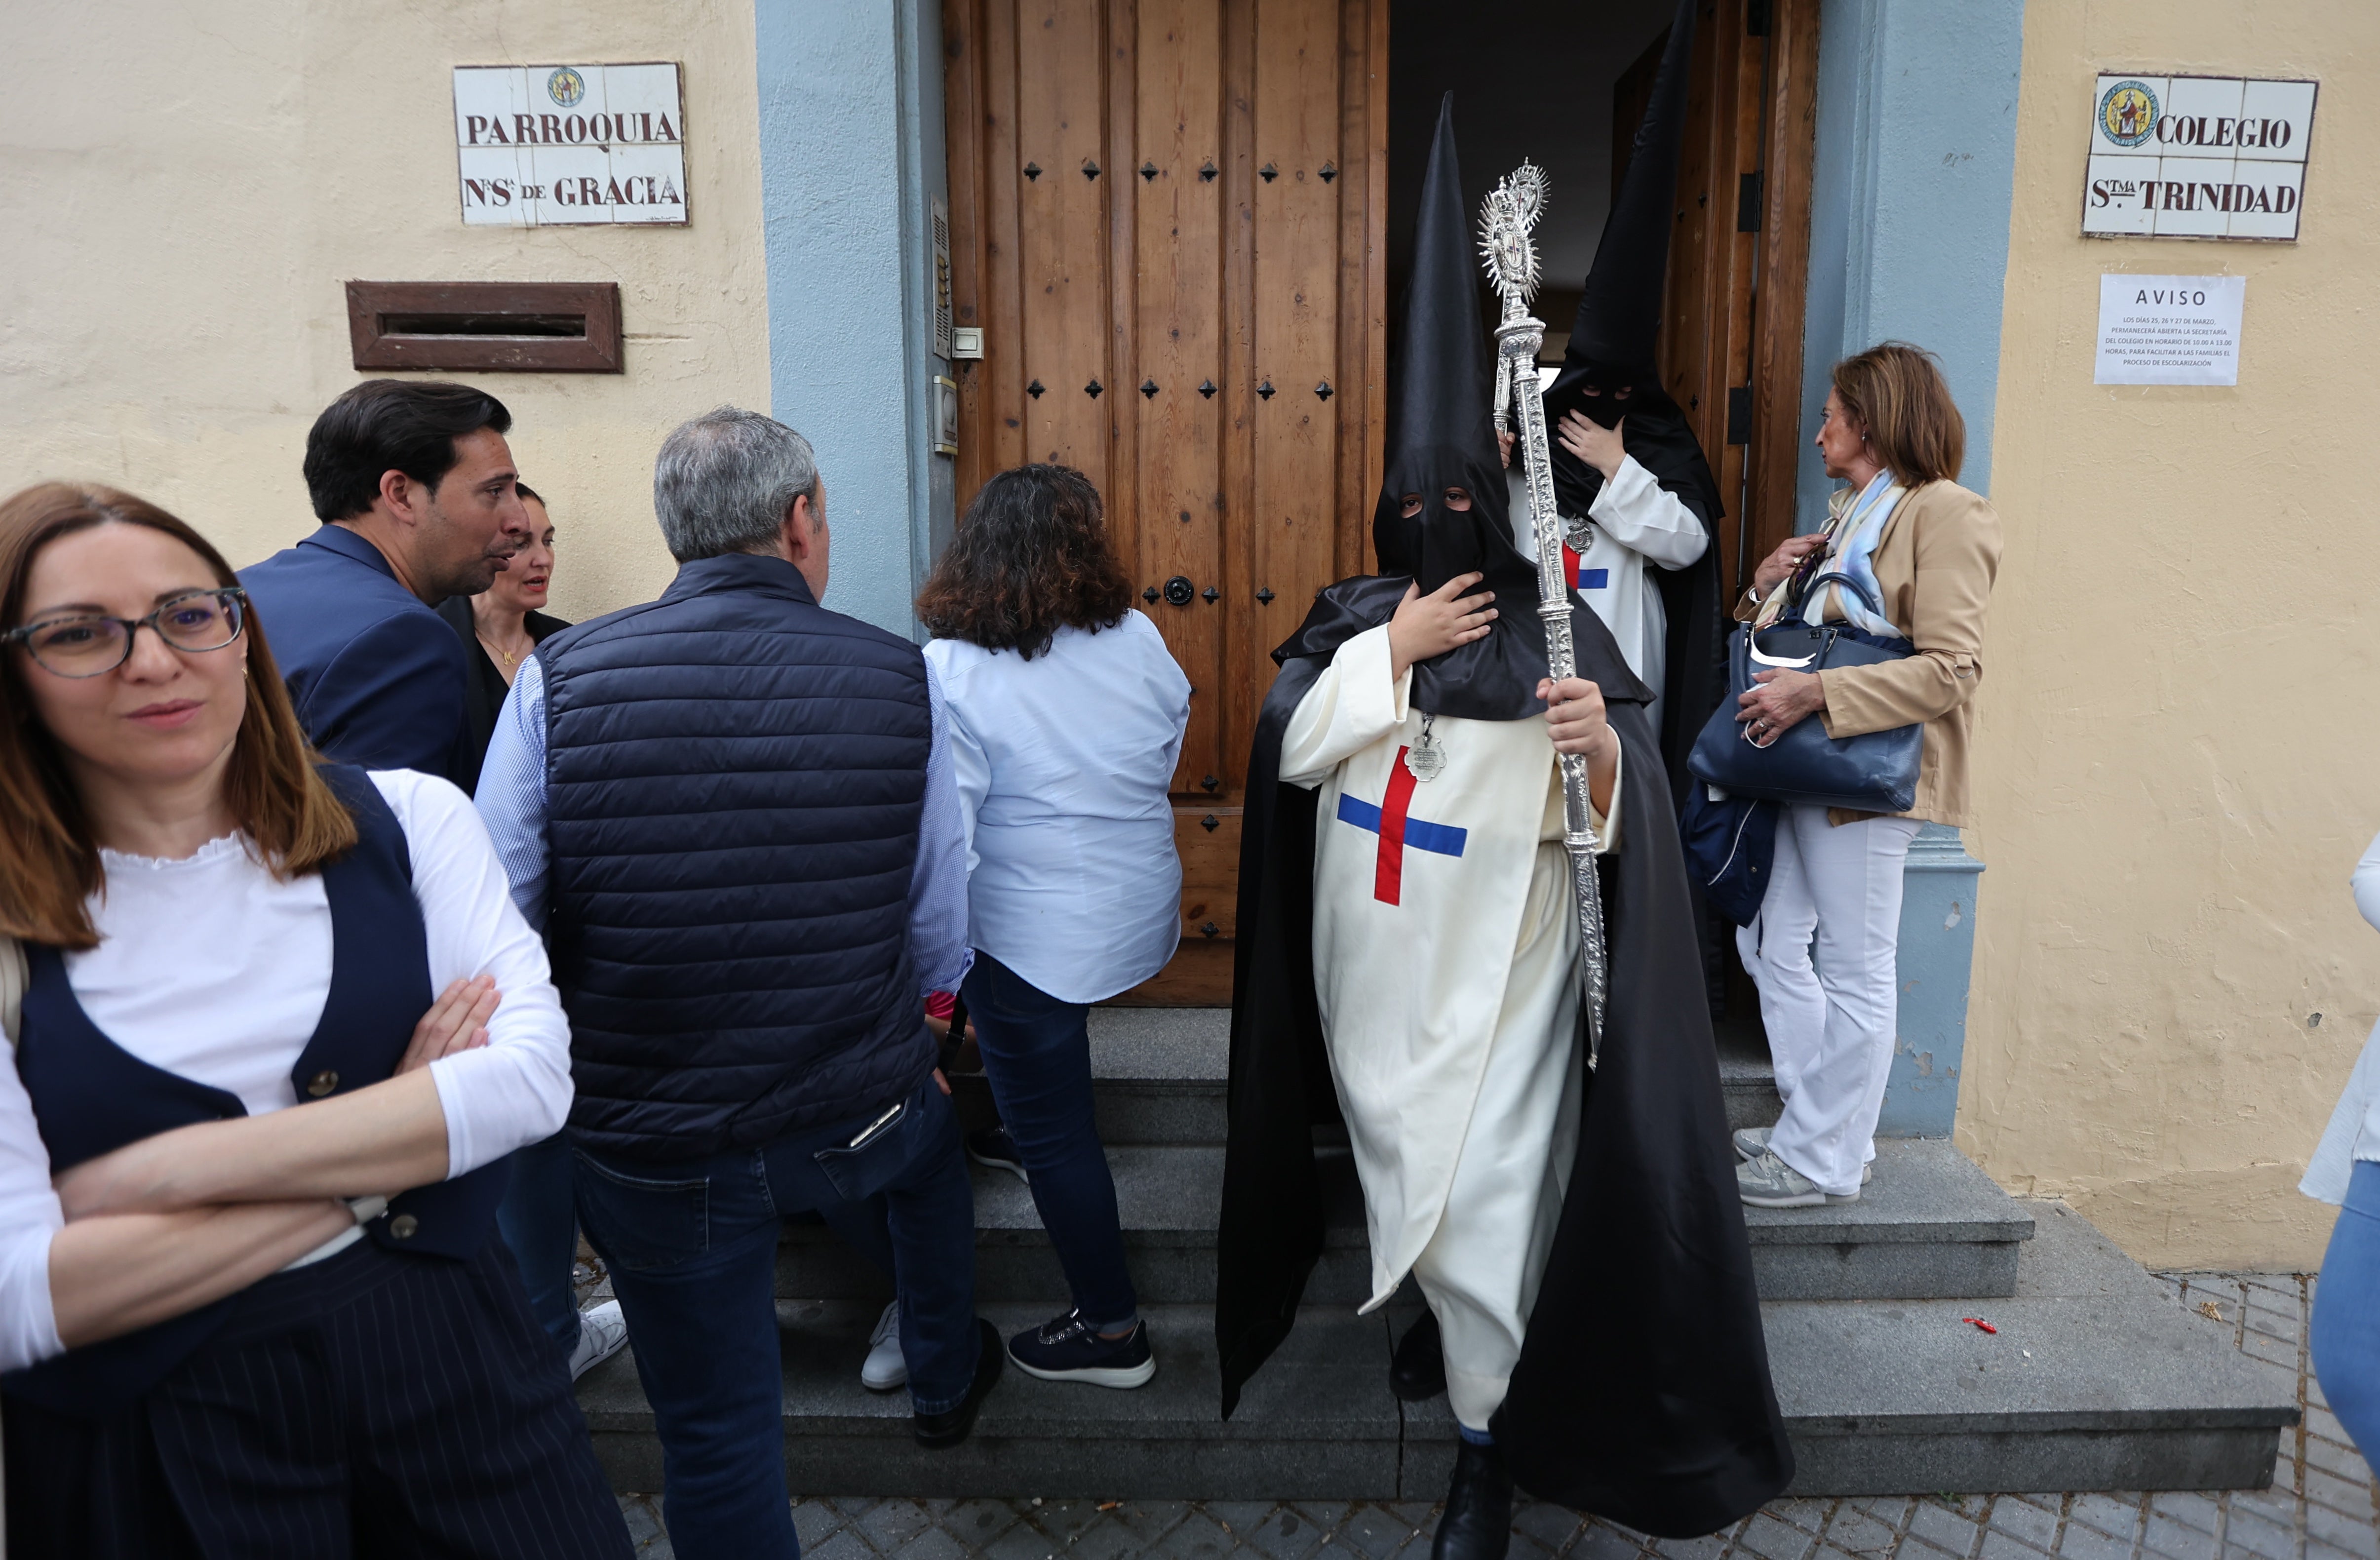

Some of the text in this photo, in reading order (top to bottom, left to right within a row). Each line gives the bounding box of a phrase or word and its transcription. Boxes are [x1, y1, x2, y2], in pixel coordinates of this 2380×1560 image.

[465, 111, 679, 144] PARROQUIA
[2156, 115, 2291, 148] COLEGIO
[521, 185, 546, 198] DE
[554, 176, 682, 206] GRACIA
[2139, 181, 2297, 213] TRINIDAD
[2136, 290, 2206, 306] AVISO
